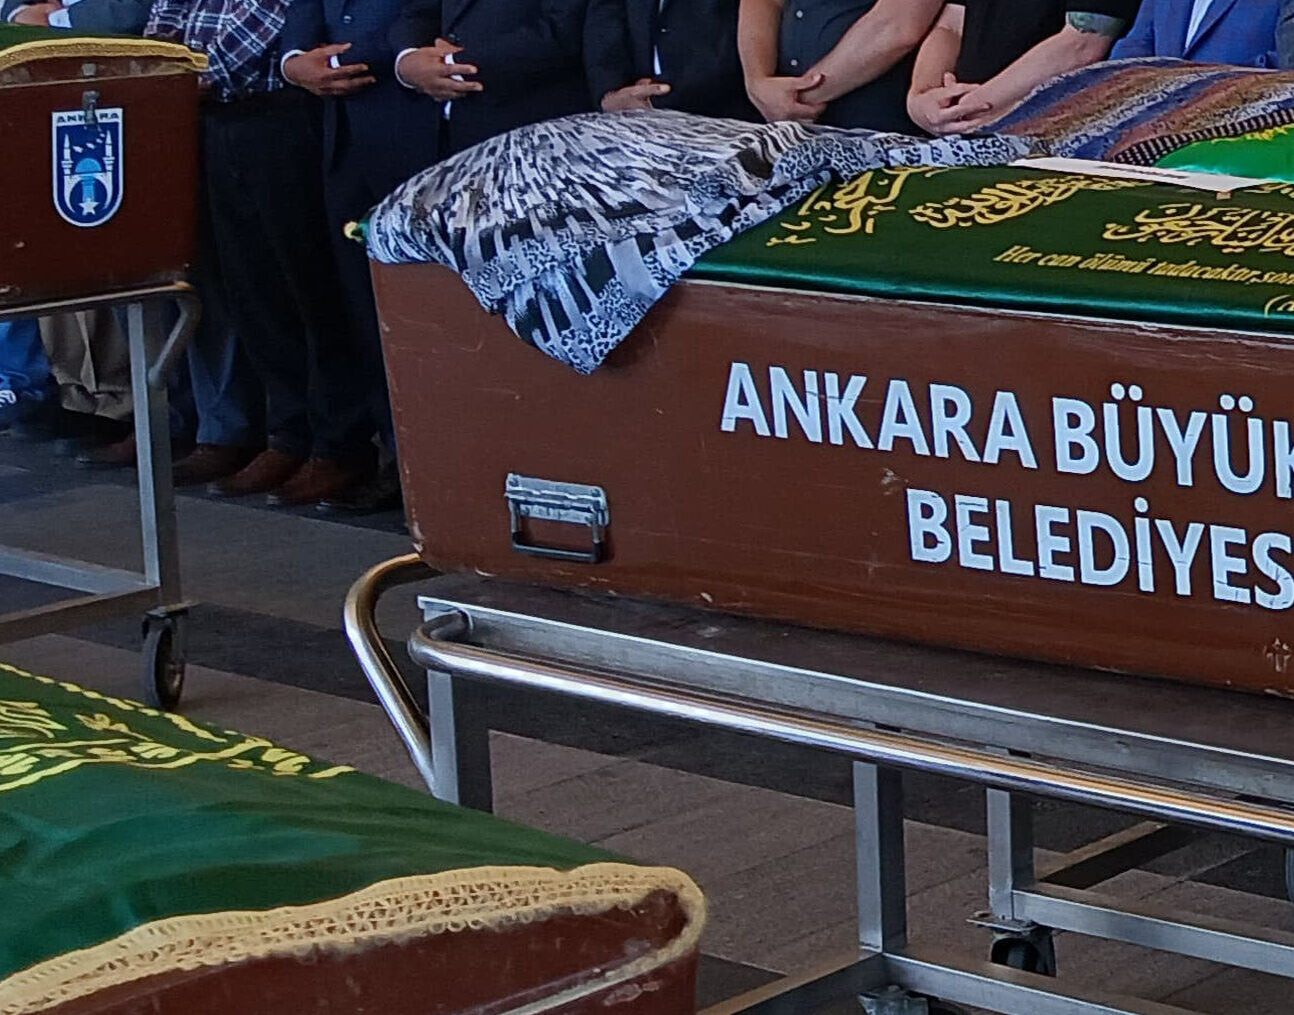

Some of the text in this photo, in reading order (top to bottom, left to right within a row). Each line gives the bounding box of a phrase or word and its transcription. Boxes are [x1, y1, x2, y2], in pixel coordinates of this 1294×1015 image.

[993, 245, 1041, 264] Her
[1037, 253, 1082, 267] can
[1078, 252, 1157, 273] ölümü
[720, 360, 1039, 470] ANKARA
